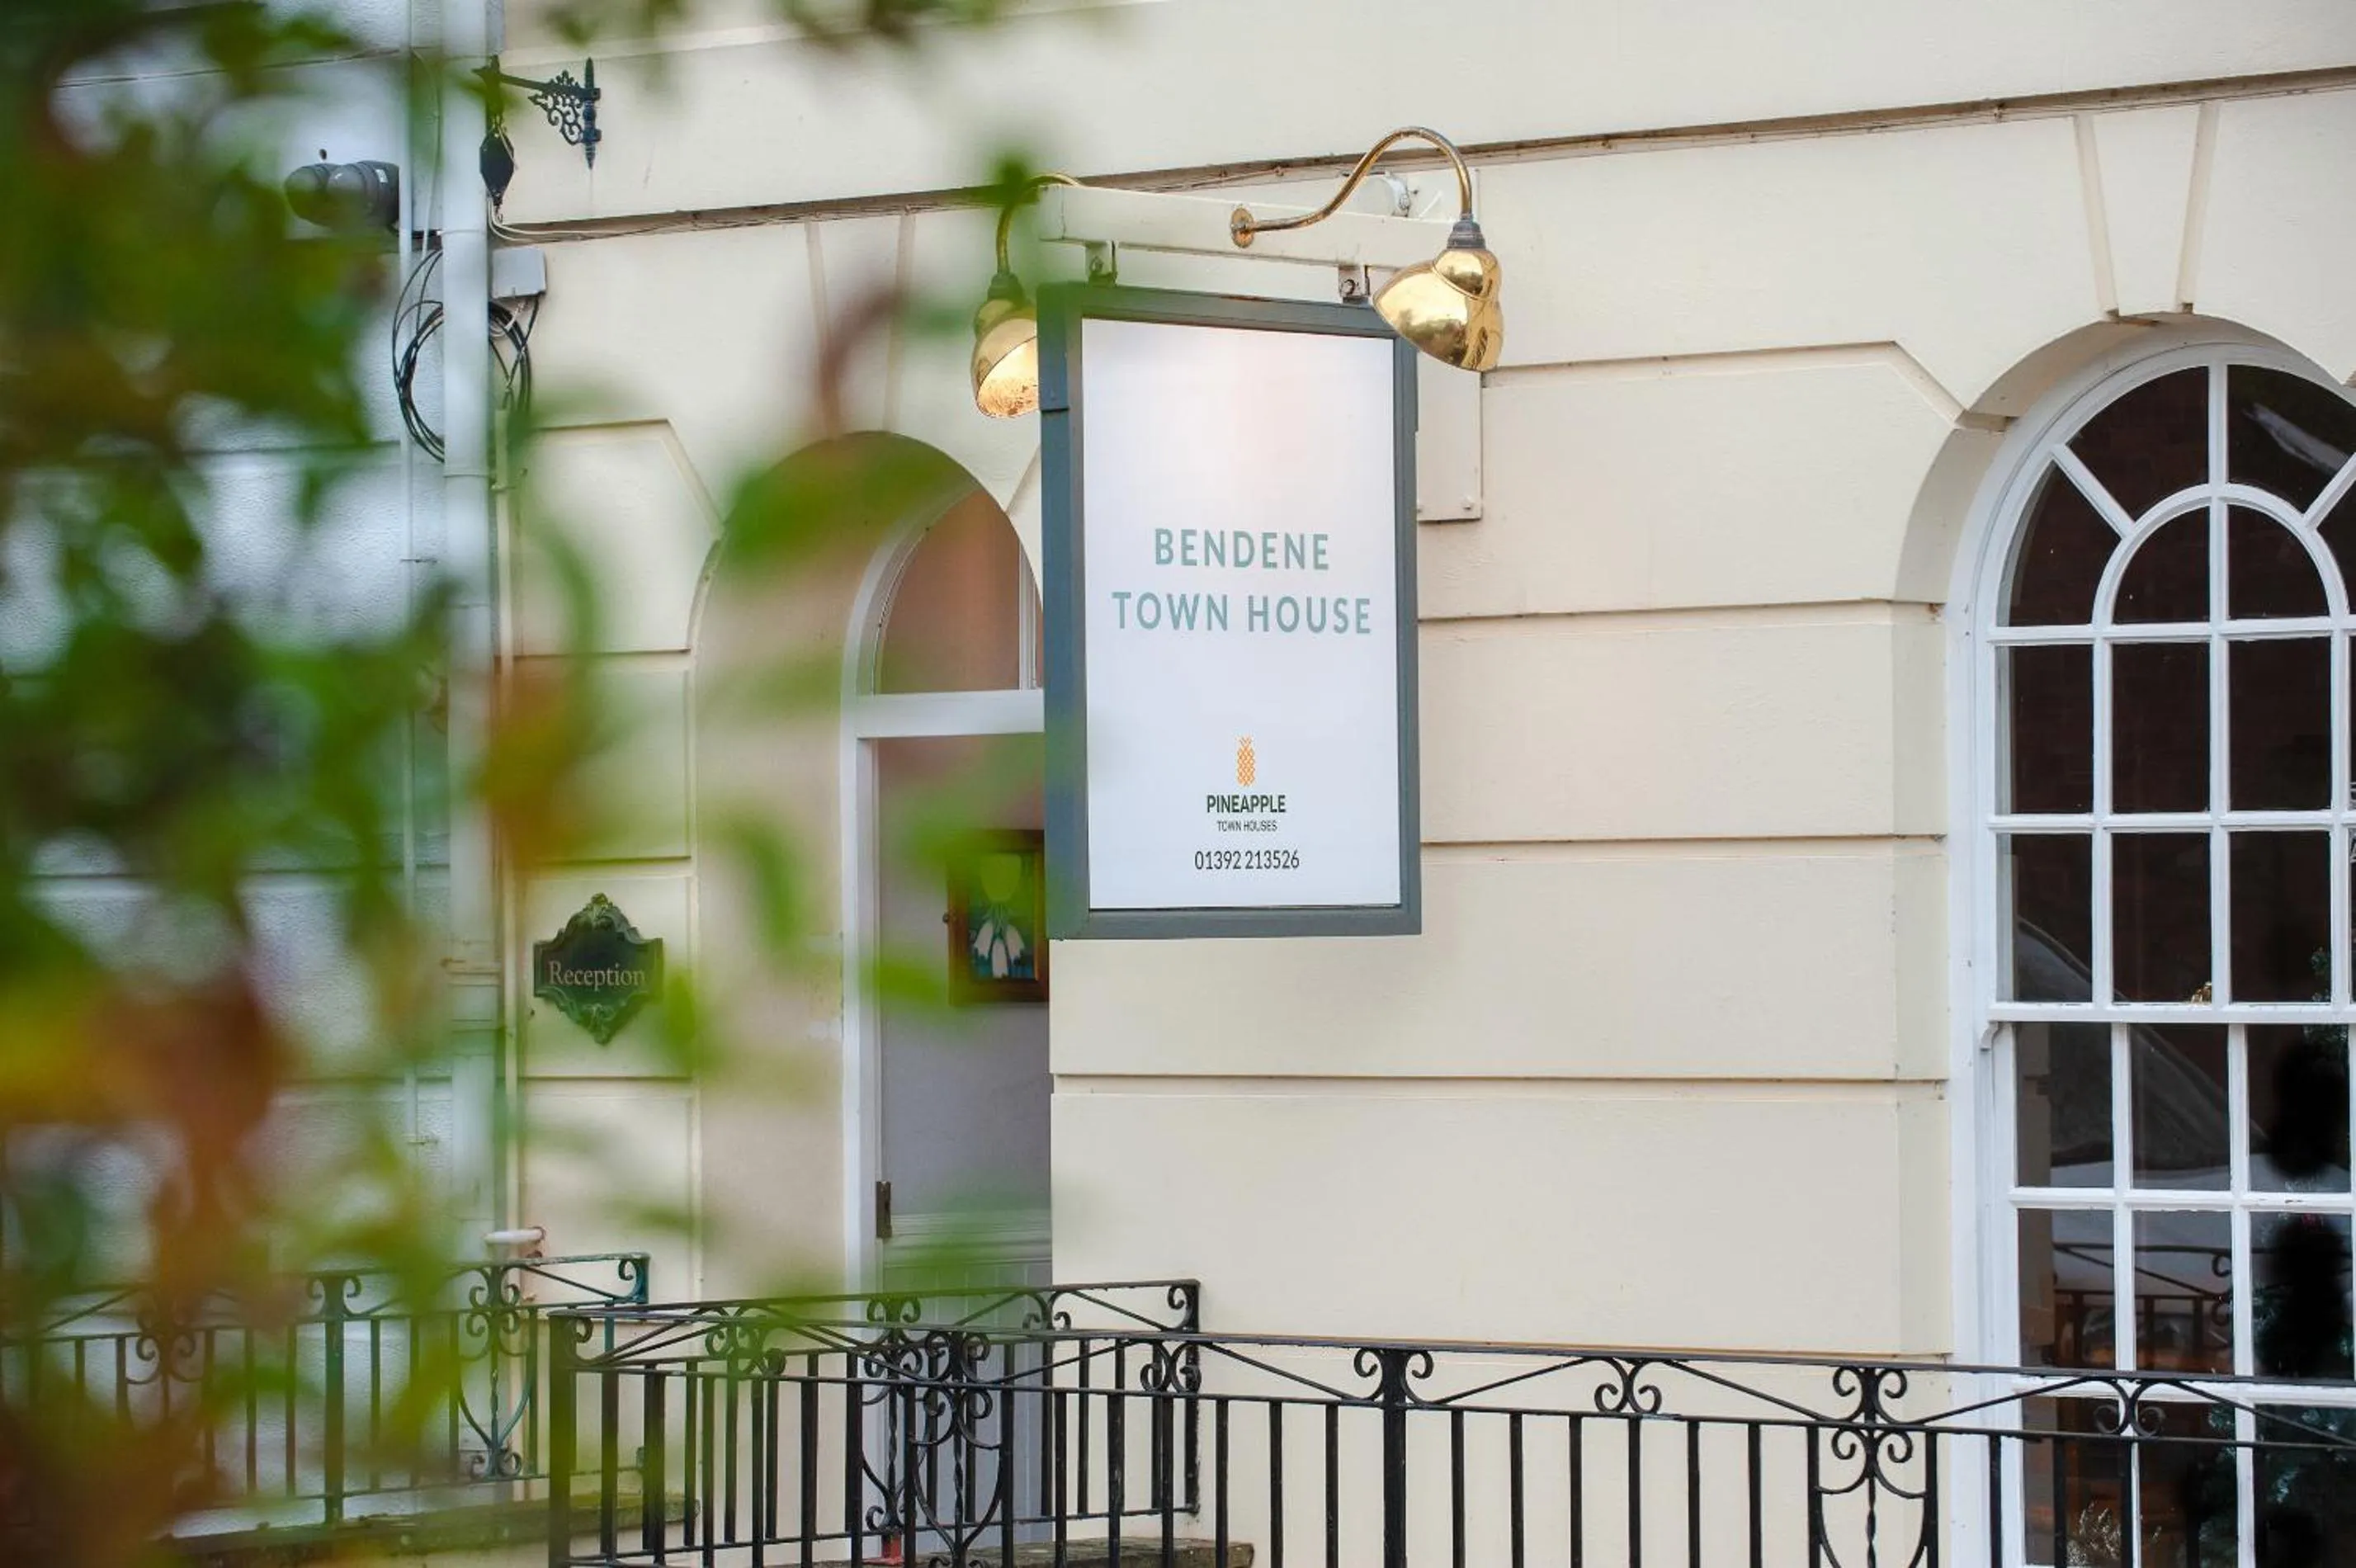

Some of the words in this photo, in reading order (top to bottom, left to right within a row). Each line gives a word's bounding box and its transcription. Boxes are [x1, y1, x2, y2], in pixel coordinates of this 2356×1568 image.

[1155, 528, 1329, 570] BENDENE
[1112, 592, 1227, 631] TOWN
[1249, 595, 1371, 634] HOUSE
[1206, 795, 1286, 813] PINEAPPLE
[1217, 820, 1241, 832] TOWN
[1244, 820, 1277, 832] HOUSES
[1195, 850, 1241, 870] 01392
[1245, 849, 1299, 869] 213526
[550, 961, 644, 991] Reception
